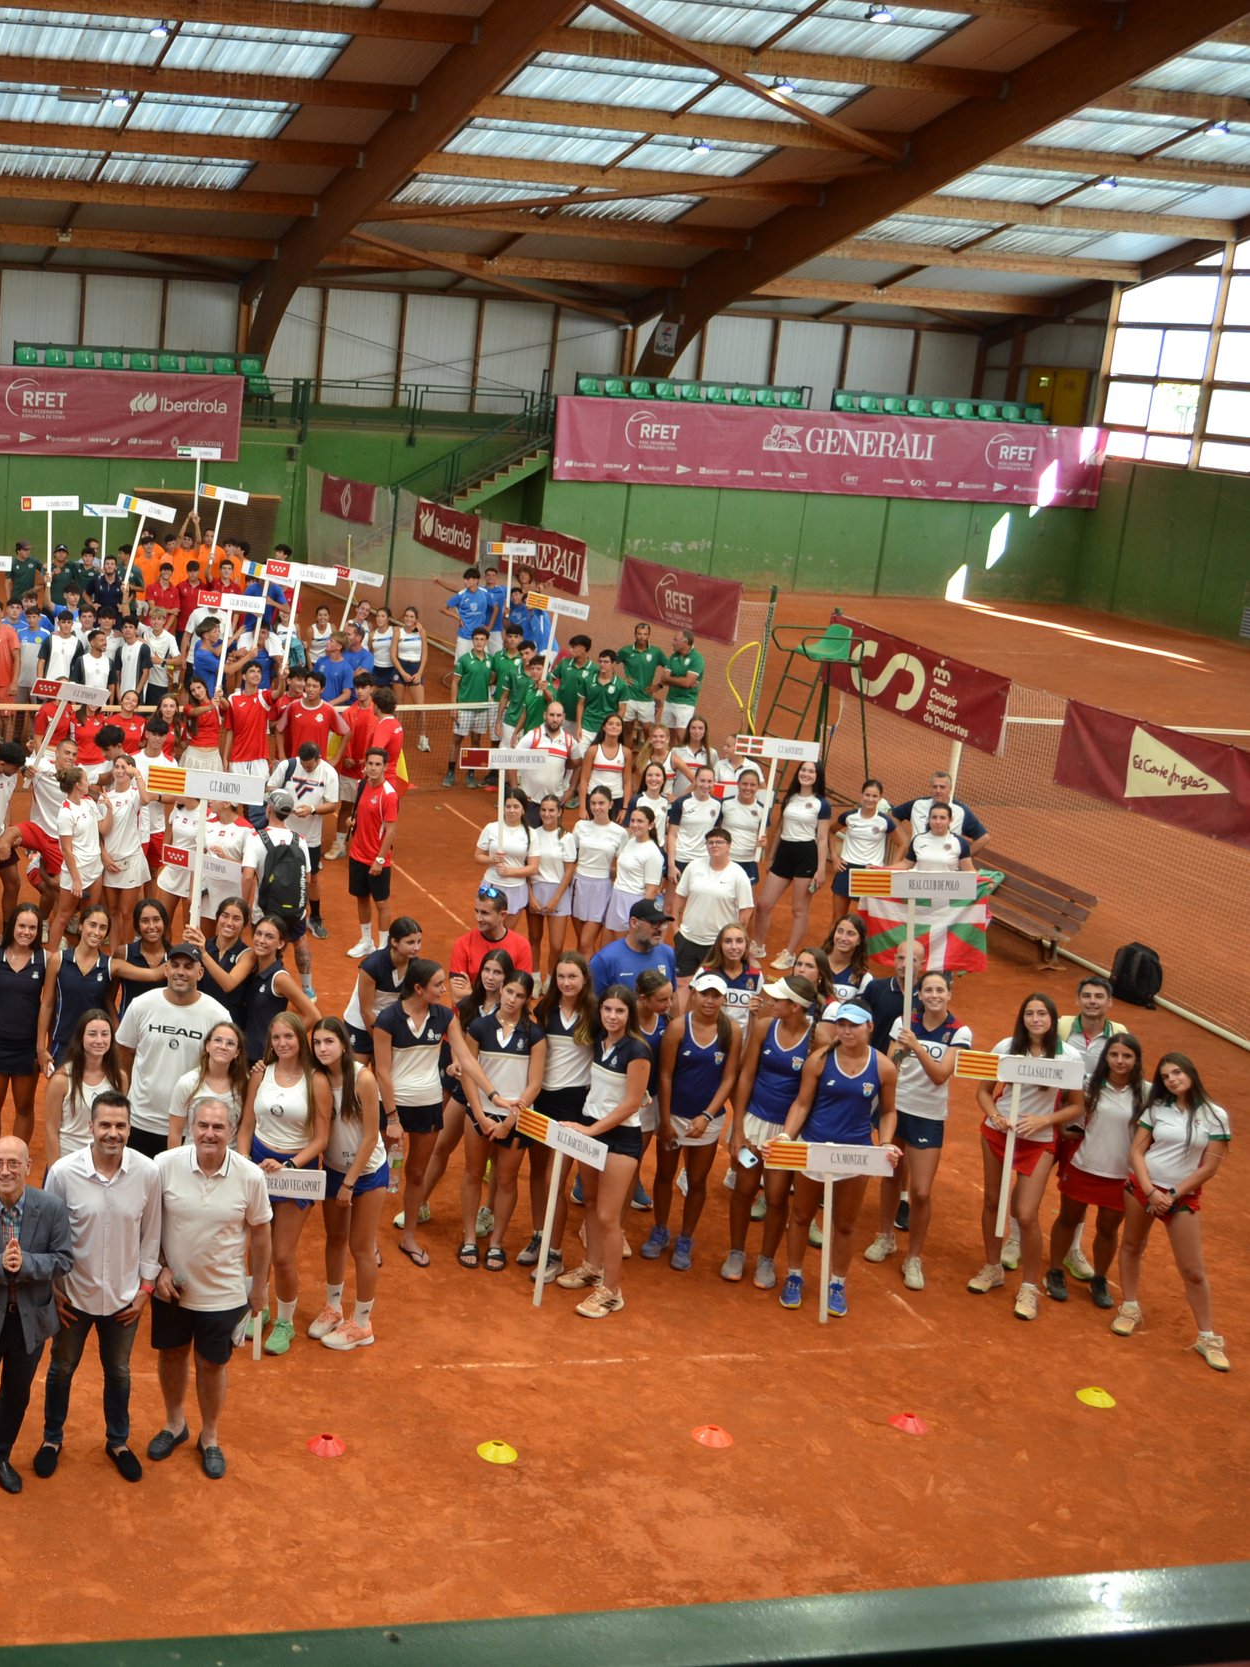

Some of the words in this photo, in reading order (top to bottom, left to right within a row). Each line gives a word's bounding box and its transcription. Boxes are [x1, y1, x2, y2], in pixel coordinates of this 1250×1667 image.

[22, 391, 67, 408] RFET
[160, 397, 227, 414] Iberdrola
[639, 424, 680, 440] RFET
[805, 427, 936, 461] GENERALI
[999, 445, 1037, 461] RFET
[665, 589, 694, 614] RFET
[929, 687, 958, 708] Consejo
[926, 699, 957, 720] Superior
[923, 714, 933, 724] de
[934, 716, 969, 738] Deportes
[1132, 754, 1143, 770] El
[1143, 759, 1168, 779] Corte
[1168, 763, 1209, 791] Inglés
[219, 781, 241, 795] BARCINO
[908, 879, 922, 890] REAL
[922, 879, 937, 890] CLUB
[937, 880, 944, 890] DE
[945, 880, 959, 891] POLO
[725, 993, 750, 1005] DO
[148, 1024, 203, 1040] HEAD
[1035, 1067, 1052, 1079] SALUT
[266, 1178, 290, 1191] DERADO
[290, 1179, 321, 1193] VEGASPORT
